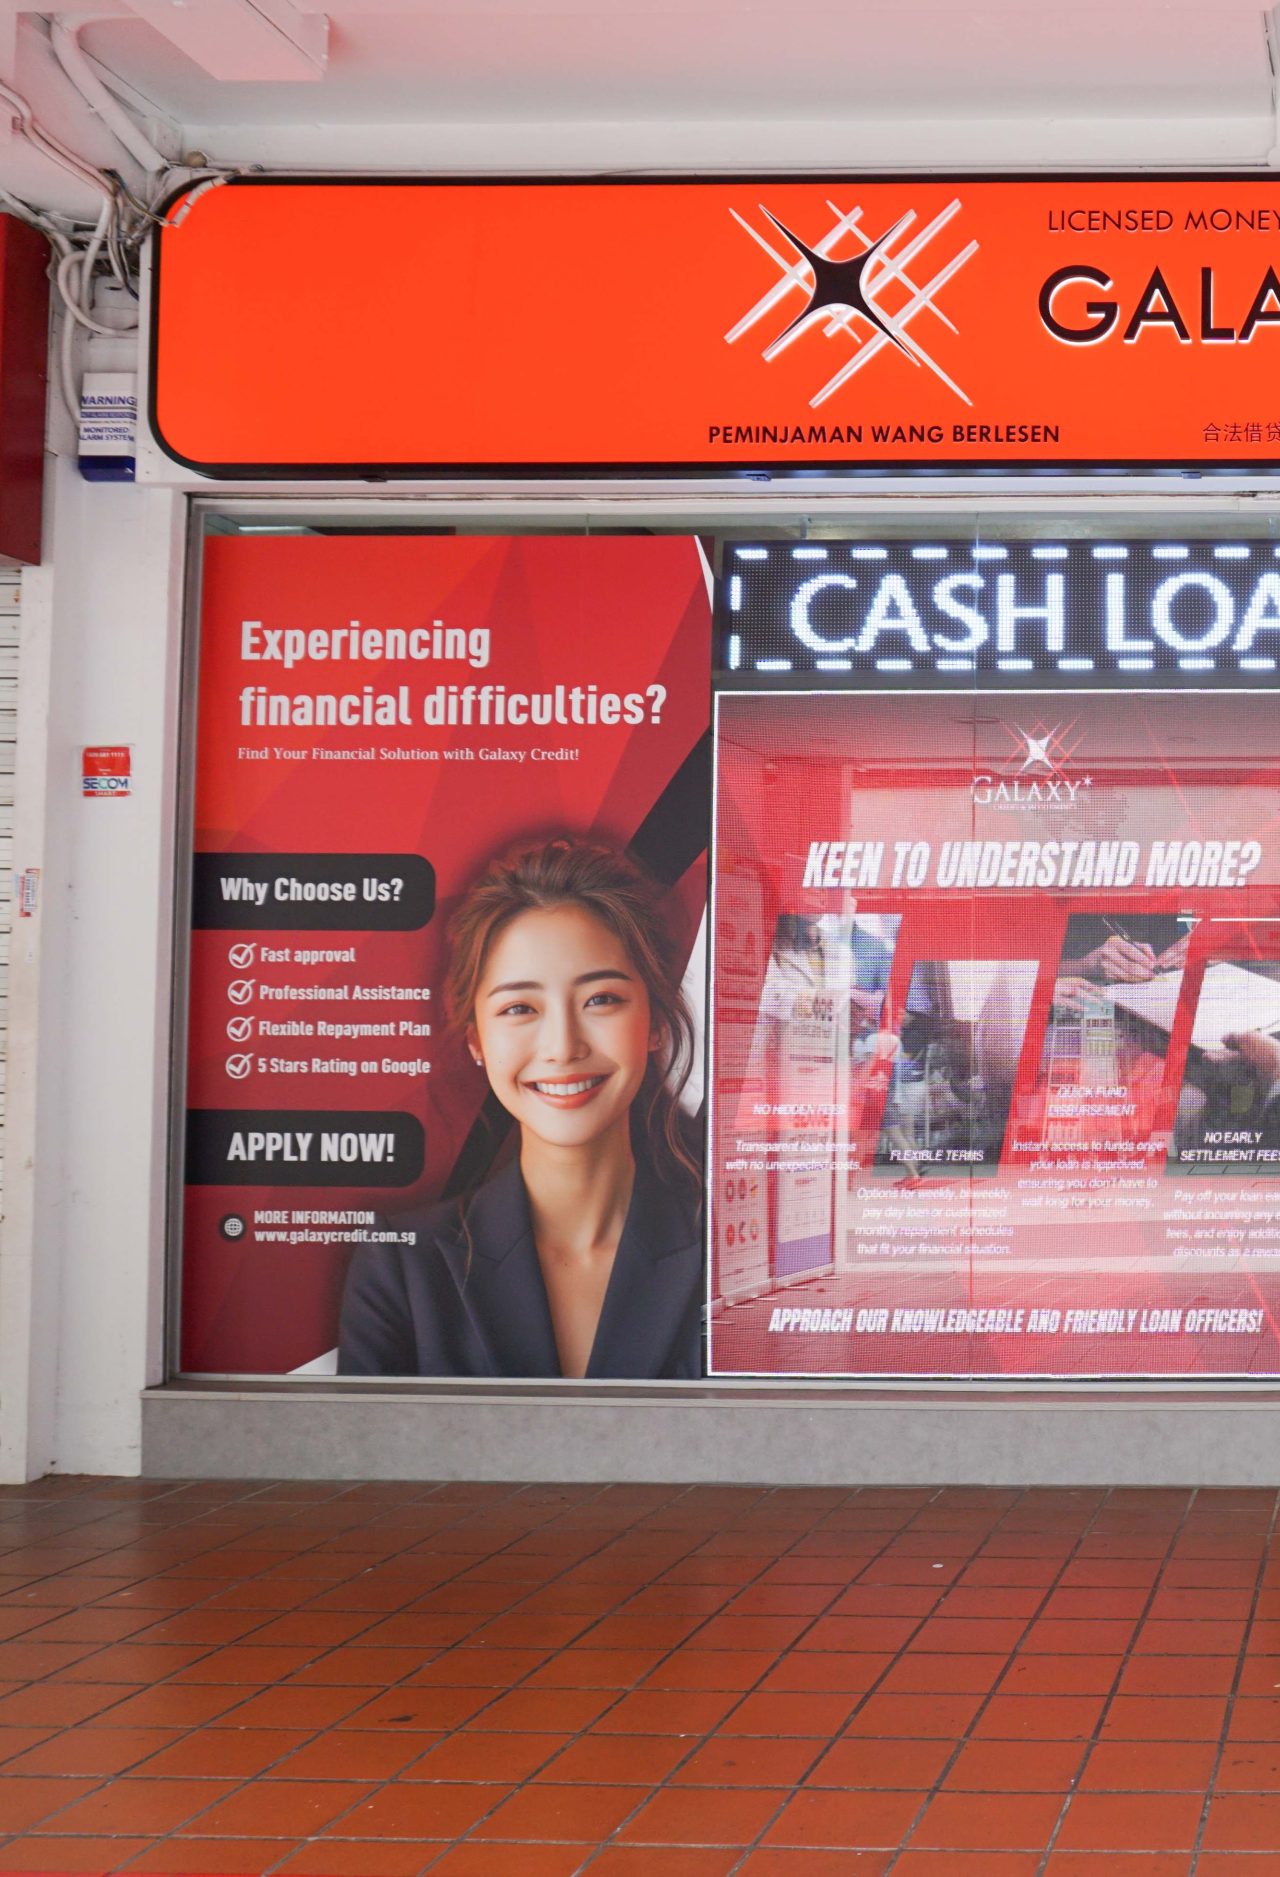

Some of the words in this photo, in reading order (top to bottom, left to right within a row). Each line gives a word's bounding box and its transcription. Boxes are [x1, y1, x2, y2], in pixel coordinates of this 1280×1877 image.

[1048, 210, 1174, 233] LICENSED
[708, 426, 864, 444] PEMINJAMAN
[872, 426, 946, 444] WANG
[952, 426, 1060, 443] BERLESEN
[790, 572, 1066, 653] CASH
[241, 620, 491, 668] Experiencing
[239, 685, 412, 725] financial
[424, 684, 667, 725] difficulties?
[238, 747, 268, 760] Find
[273, 747, 308, 760] Your
[312, 747, 376, 760] Financial
[379, 747, 439, 760] Solution
[443, 747, 475, 760] with
[479, 747, 527, 763] Galaxy
[531, 747, 579, 760] Credit!
[83, 778, 128, 789] SECOM
[971, 776, 1081, 803] GALAXY
[802, 841, 884, 888] KEEN
[891, 841, 931, 888] TO
[936, 841, 1139, 888] UNDERSTAND
[1145, 841, 1262, 888] MORE?
[220, 877, 268, 905] Why
[274, 877, 356, 901] Choose
[363, 878, 404, 901] Us?
[260, 947, 290, 962] Fast
[294, 947, 356, 965] approval
[260, 985, 349, 1000] Professional
[352, 985, 431, 1000] Assistance
[258, 1021, 313, 1036] Flexible
[317, 1021, 396, 1039] Repayment
[399, 1021, 431, 1036] Plan
[257, 1058, 266, 1073] 5
[270, 1058, 308, 1073] Stars
[311, 1058, 357, 1076] Rating
[361, 1061, 378, 1073] on
[381, 1058, 431, 1076] Google
[752, 1104, 770, 1114] NO
[1204, 1132, 1222, 1143] NO
[1224, 1132, 1263, 1143] EARLY
[227, 1132, 313, 1161] APPLY
[320, 1133, 395, 1162] NOW!
[890, 1150, 943, 1161] FLEXIBLE
[946, 1150, 984, 1161] TERMS
[1180, 1150, 1255, 1161] SETTLEMENT
[1174, 1190, 1194, 1204] Pay
[1200, 1190, 1213, 1200] off
[1214, 1192, 1238, 1204] your
[1240, 1190, 1264, 1201] loan
[254, 1210, 288, 1224] MORE
[291, 1211, 375, 1225] INFORMATION
[255, 1229, 416, 1245] www.galaxycredit.com.sg
[769, 1308, 853, 1332] APPROACH
[856, 1308, 888, 1332] OUR
[893, 1308, 1025, 1333] KNOWLEDGEABLE
[1027, 1308, 1062, 1333] AND
[1065, 1309, 1138, 1333] FRIENDLY
[1140, 1309, 1182, 1333] LOAN
[1185, 1309, 1264, 1334] OFFICERS!
